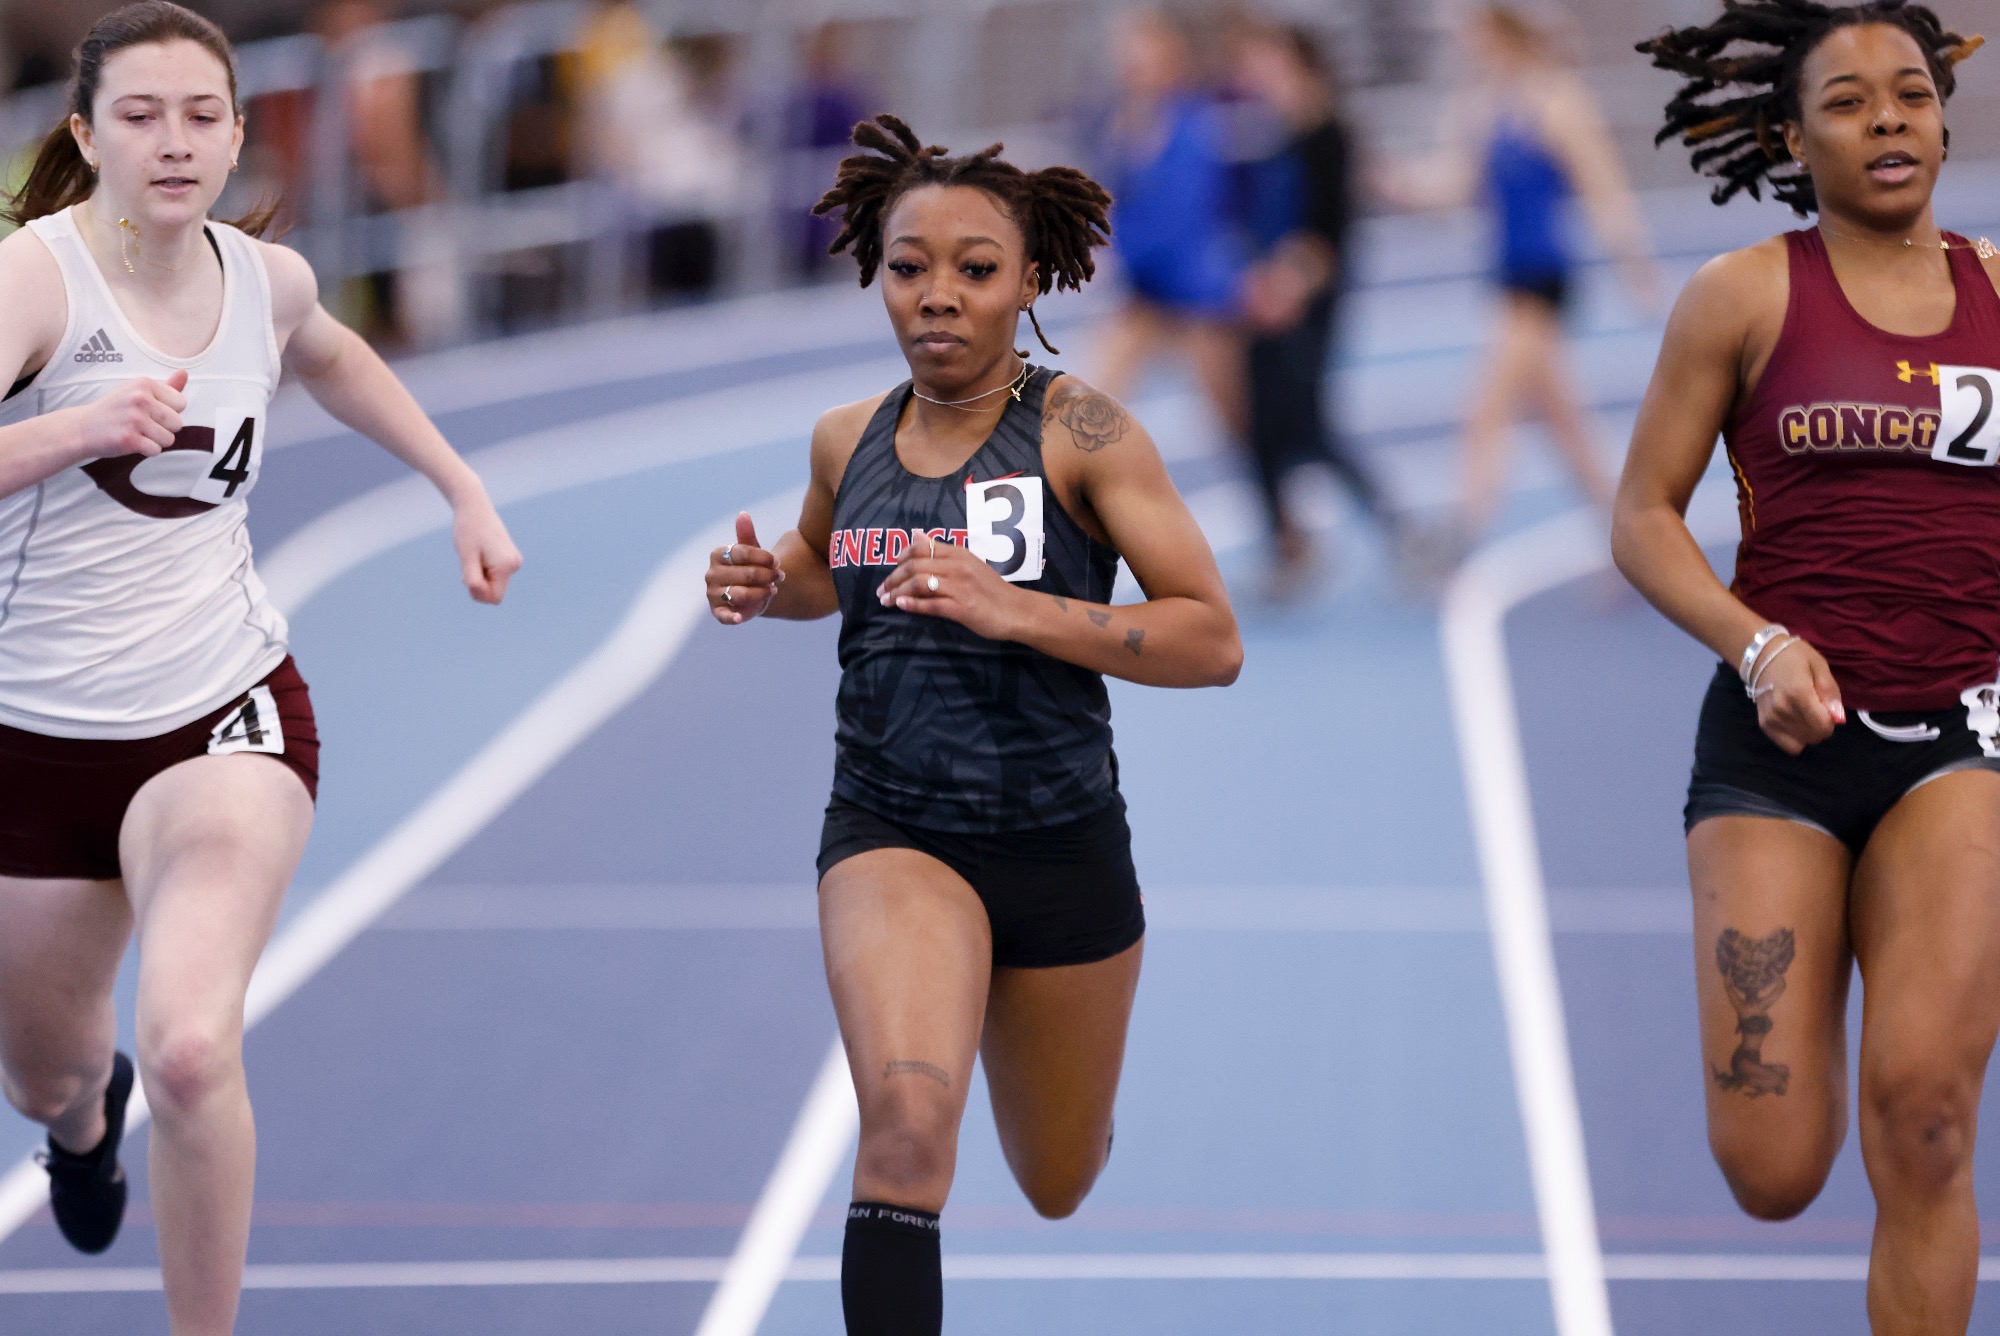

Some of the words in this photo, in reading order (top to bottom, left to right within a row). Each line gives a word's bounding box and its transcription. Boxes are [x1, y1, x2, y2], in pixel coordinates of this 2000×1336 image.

[74, 350, 124, 363] adidas
[1779, 402, 1943, 456] CONCO
[1947, 373, 1994, 462] 2
[208, 416, 256, 498] 4
[829, 527, 969, 570] ENEDT
[983, 483, 1027, 577] 3
[217, 697, 270, 746] 4
